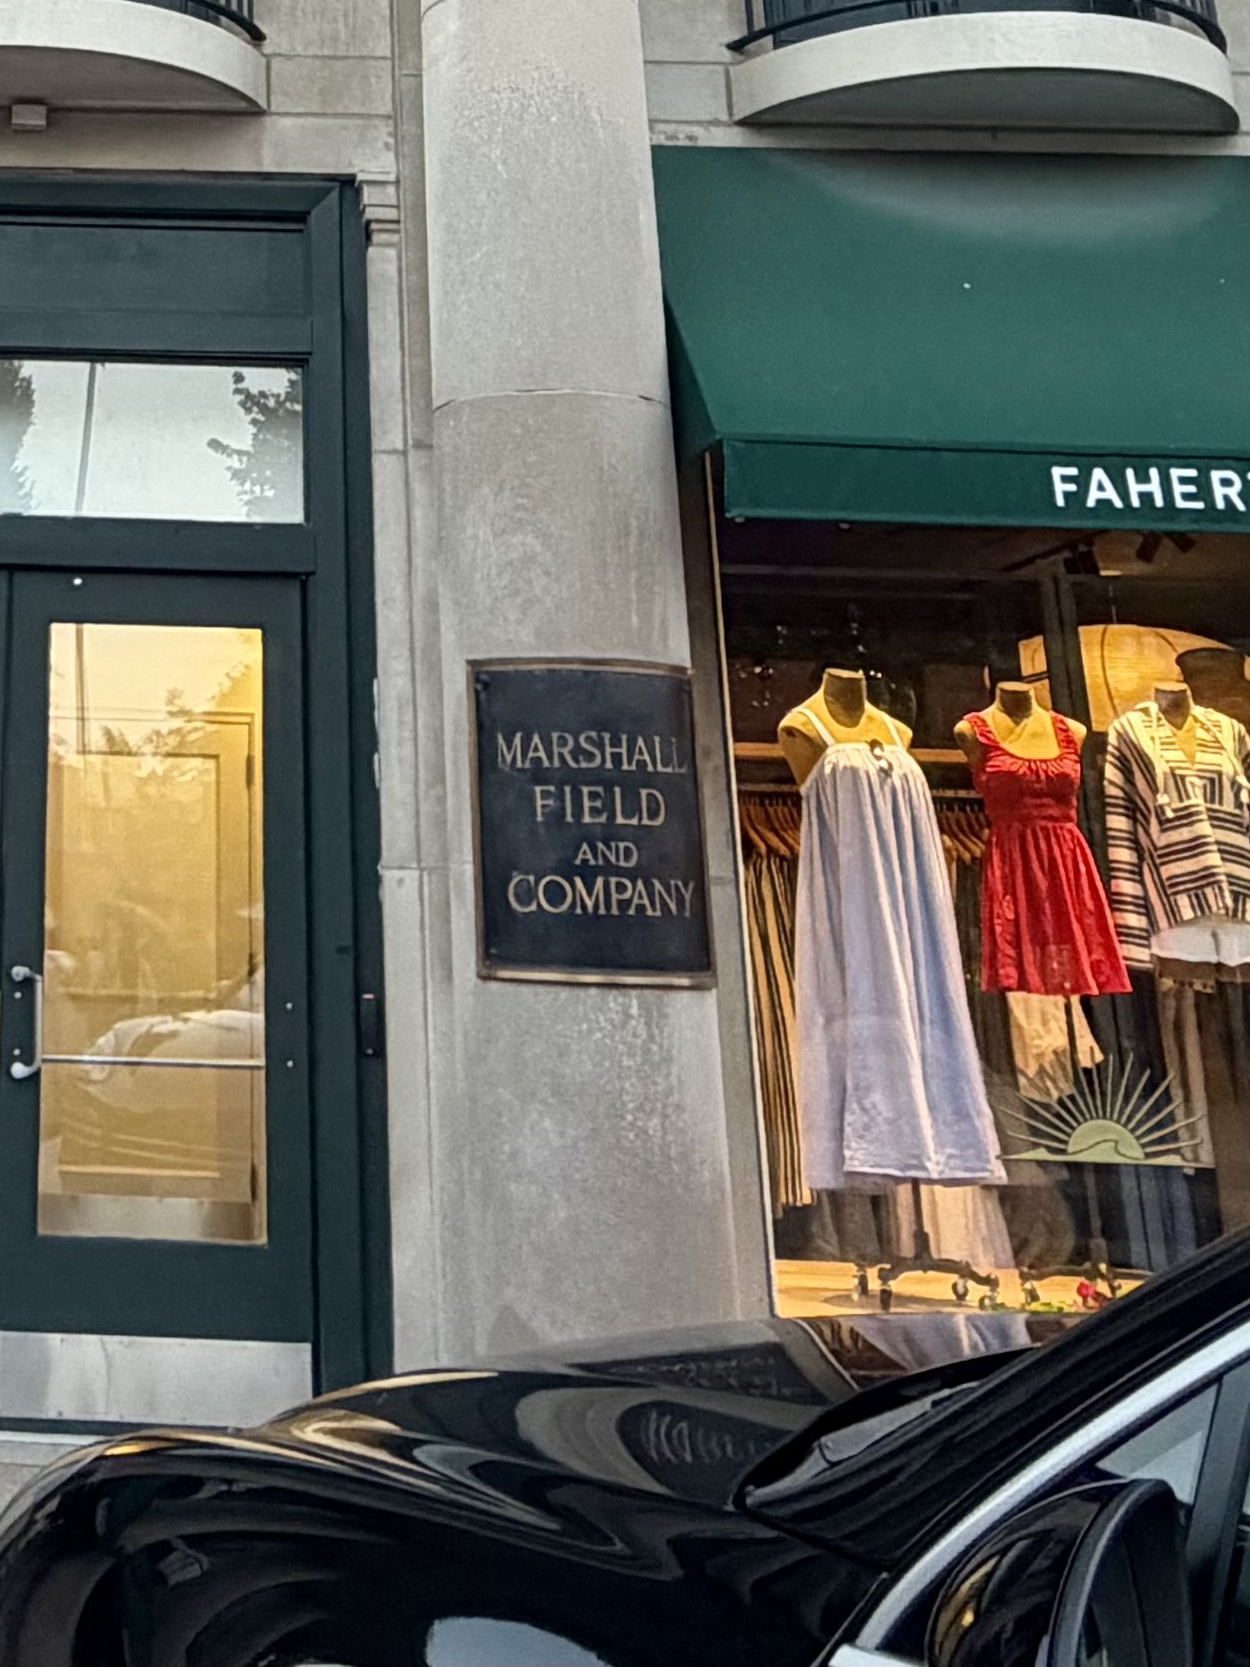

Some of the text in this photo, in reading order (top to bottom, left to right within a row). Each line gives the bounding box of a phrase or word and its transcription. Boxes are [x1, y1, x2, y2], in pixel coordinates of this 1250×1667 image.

[1050, 465, 1250, 512] FAHER
[496, 730, 687, 774] MARSHALL
[533, 785, 666, 826] FIELD
[574, 841, 639, 868] AND
[507, 874, 695, 918] COMPANY
